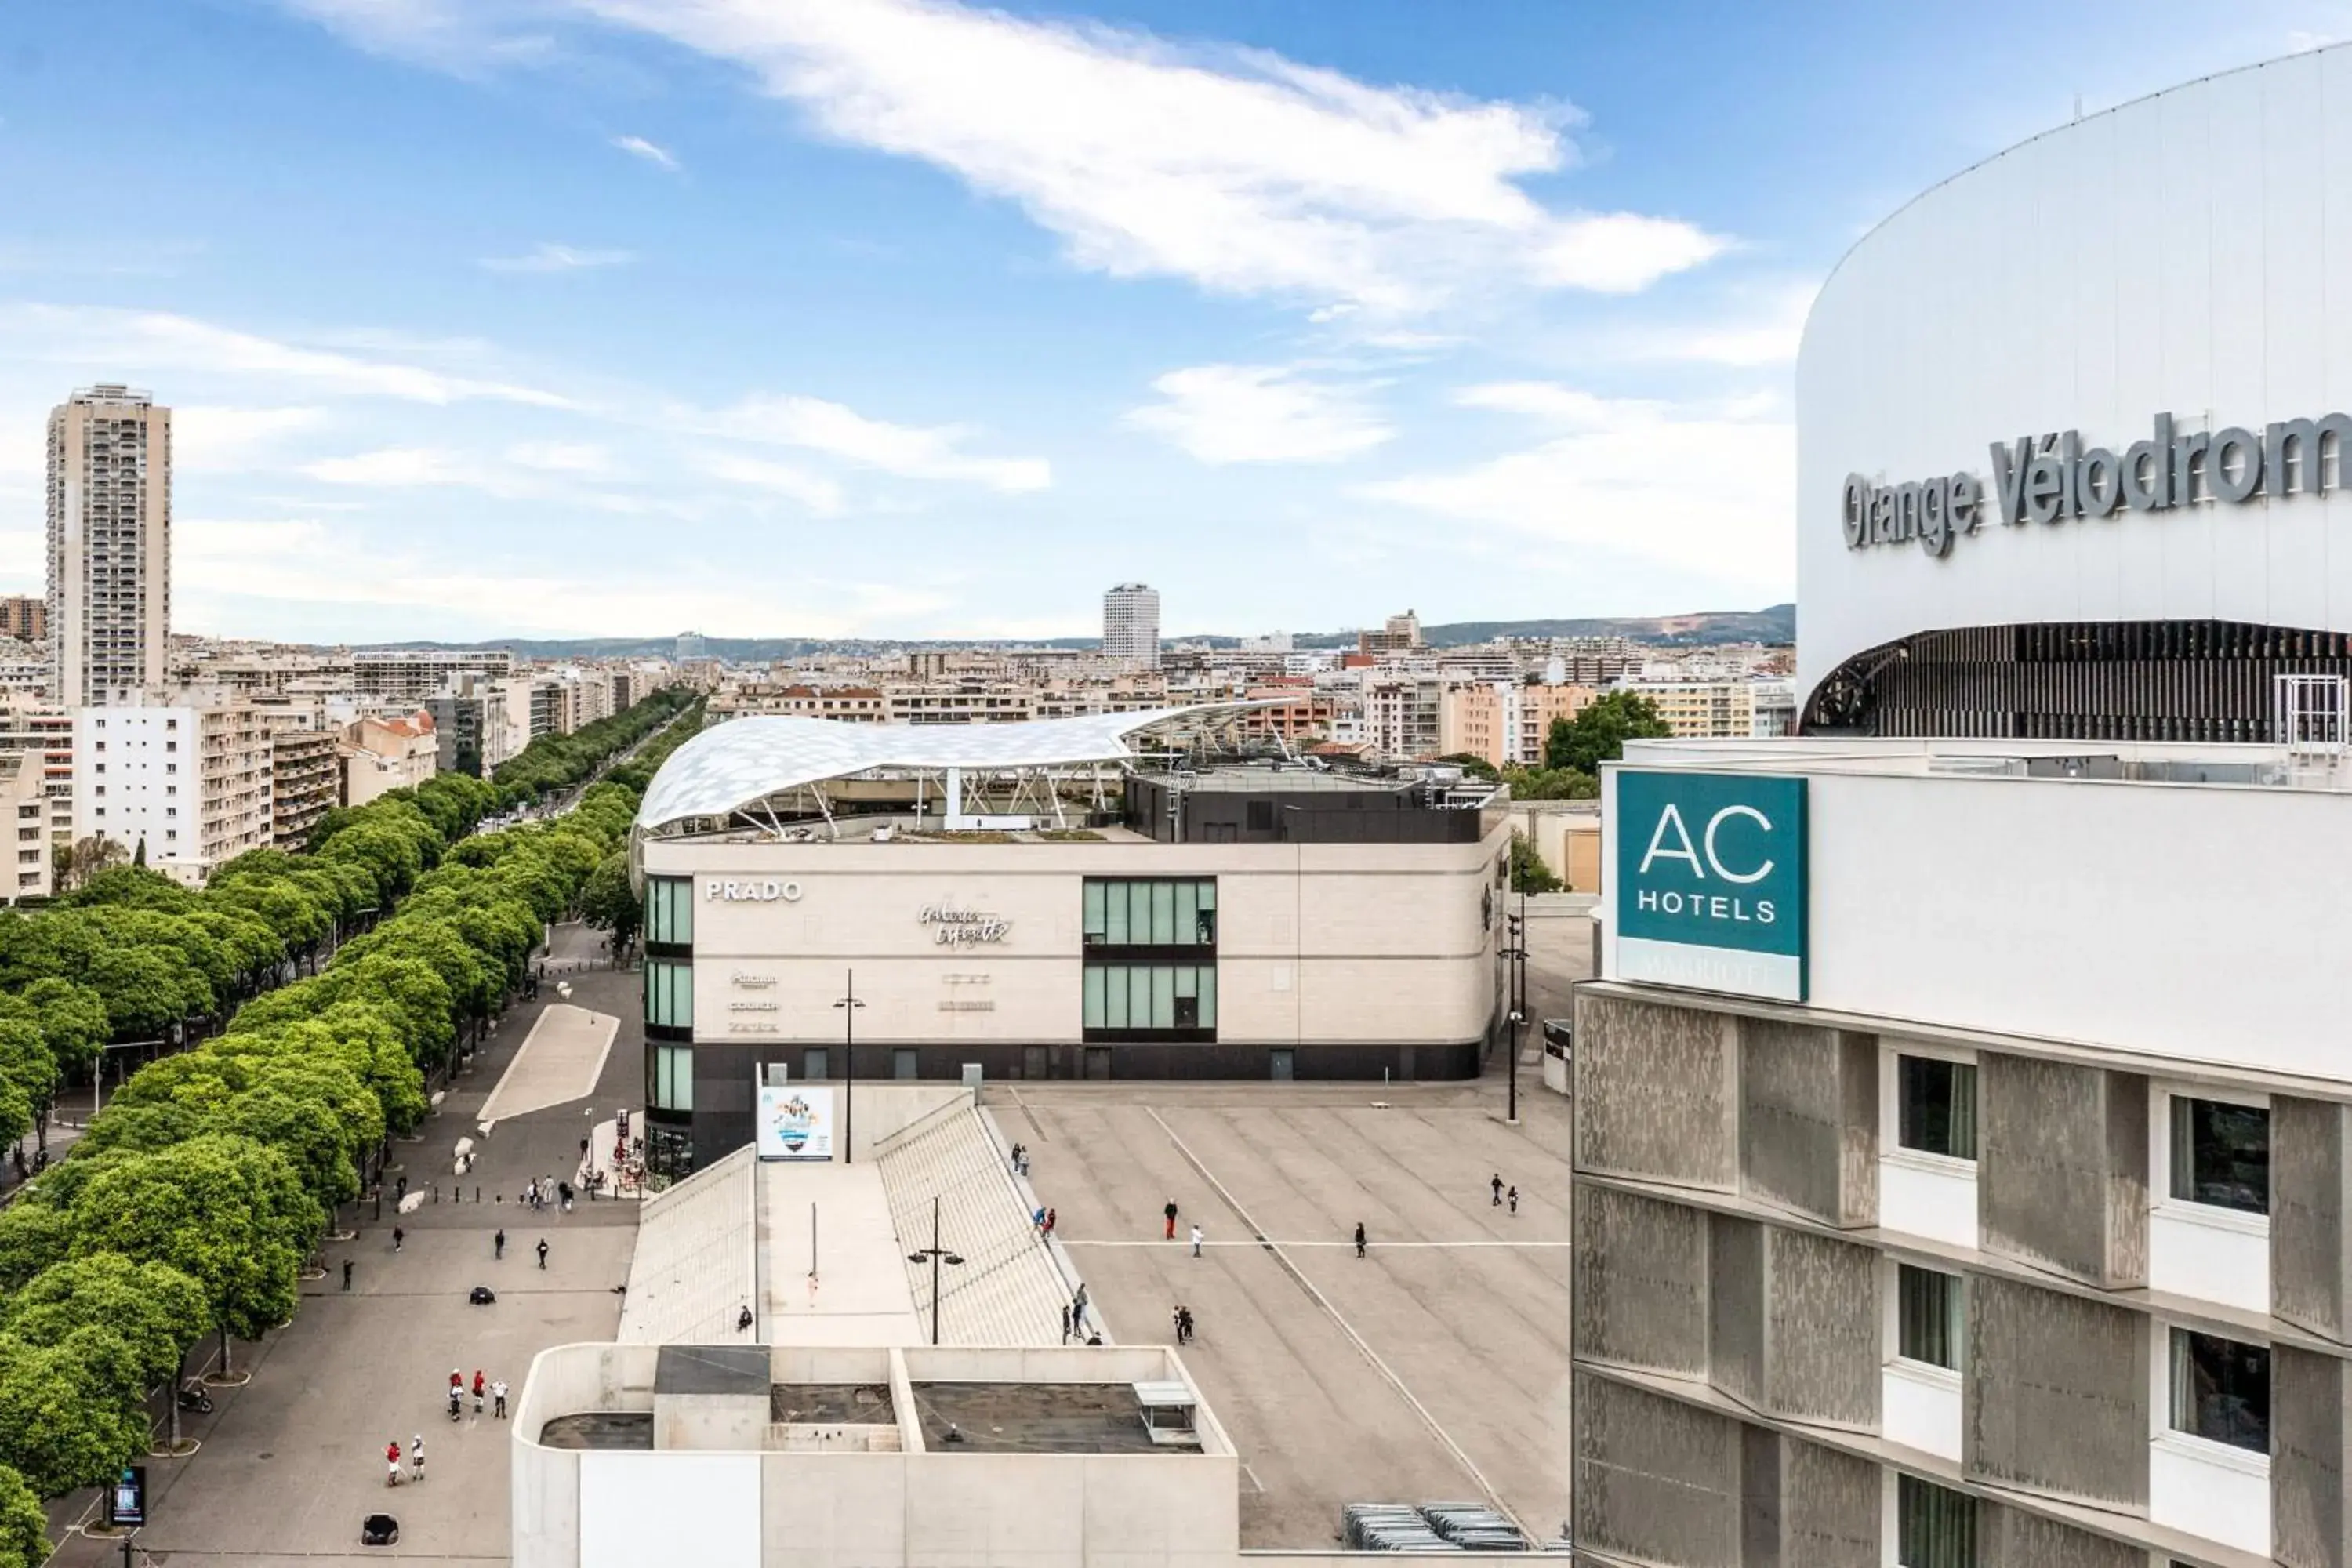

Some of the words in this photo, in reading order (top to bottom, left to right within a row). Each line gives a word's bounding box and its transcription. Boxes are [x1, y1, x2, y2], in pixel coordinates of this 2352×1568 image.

[1842, 471, 1978, 557] Orange
[1639, 804, 1775, 884] AC
[706, 880, 803, 902] PRADO
[1639, 890, 1776, 924] HOTELS
